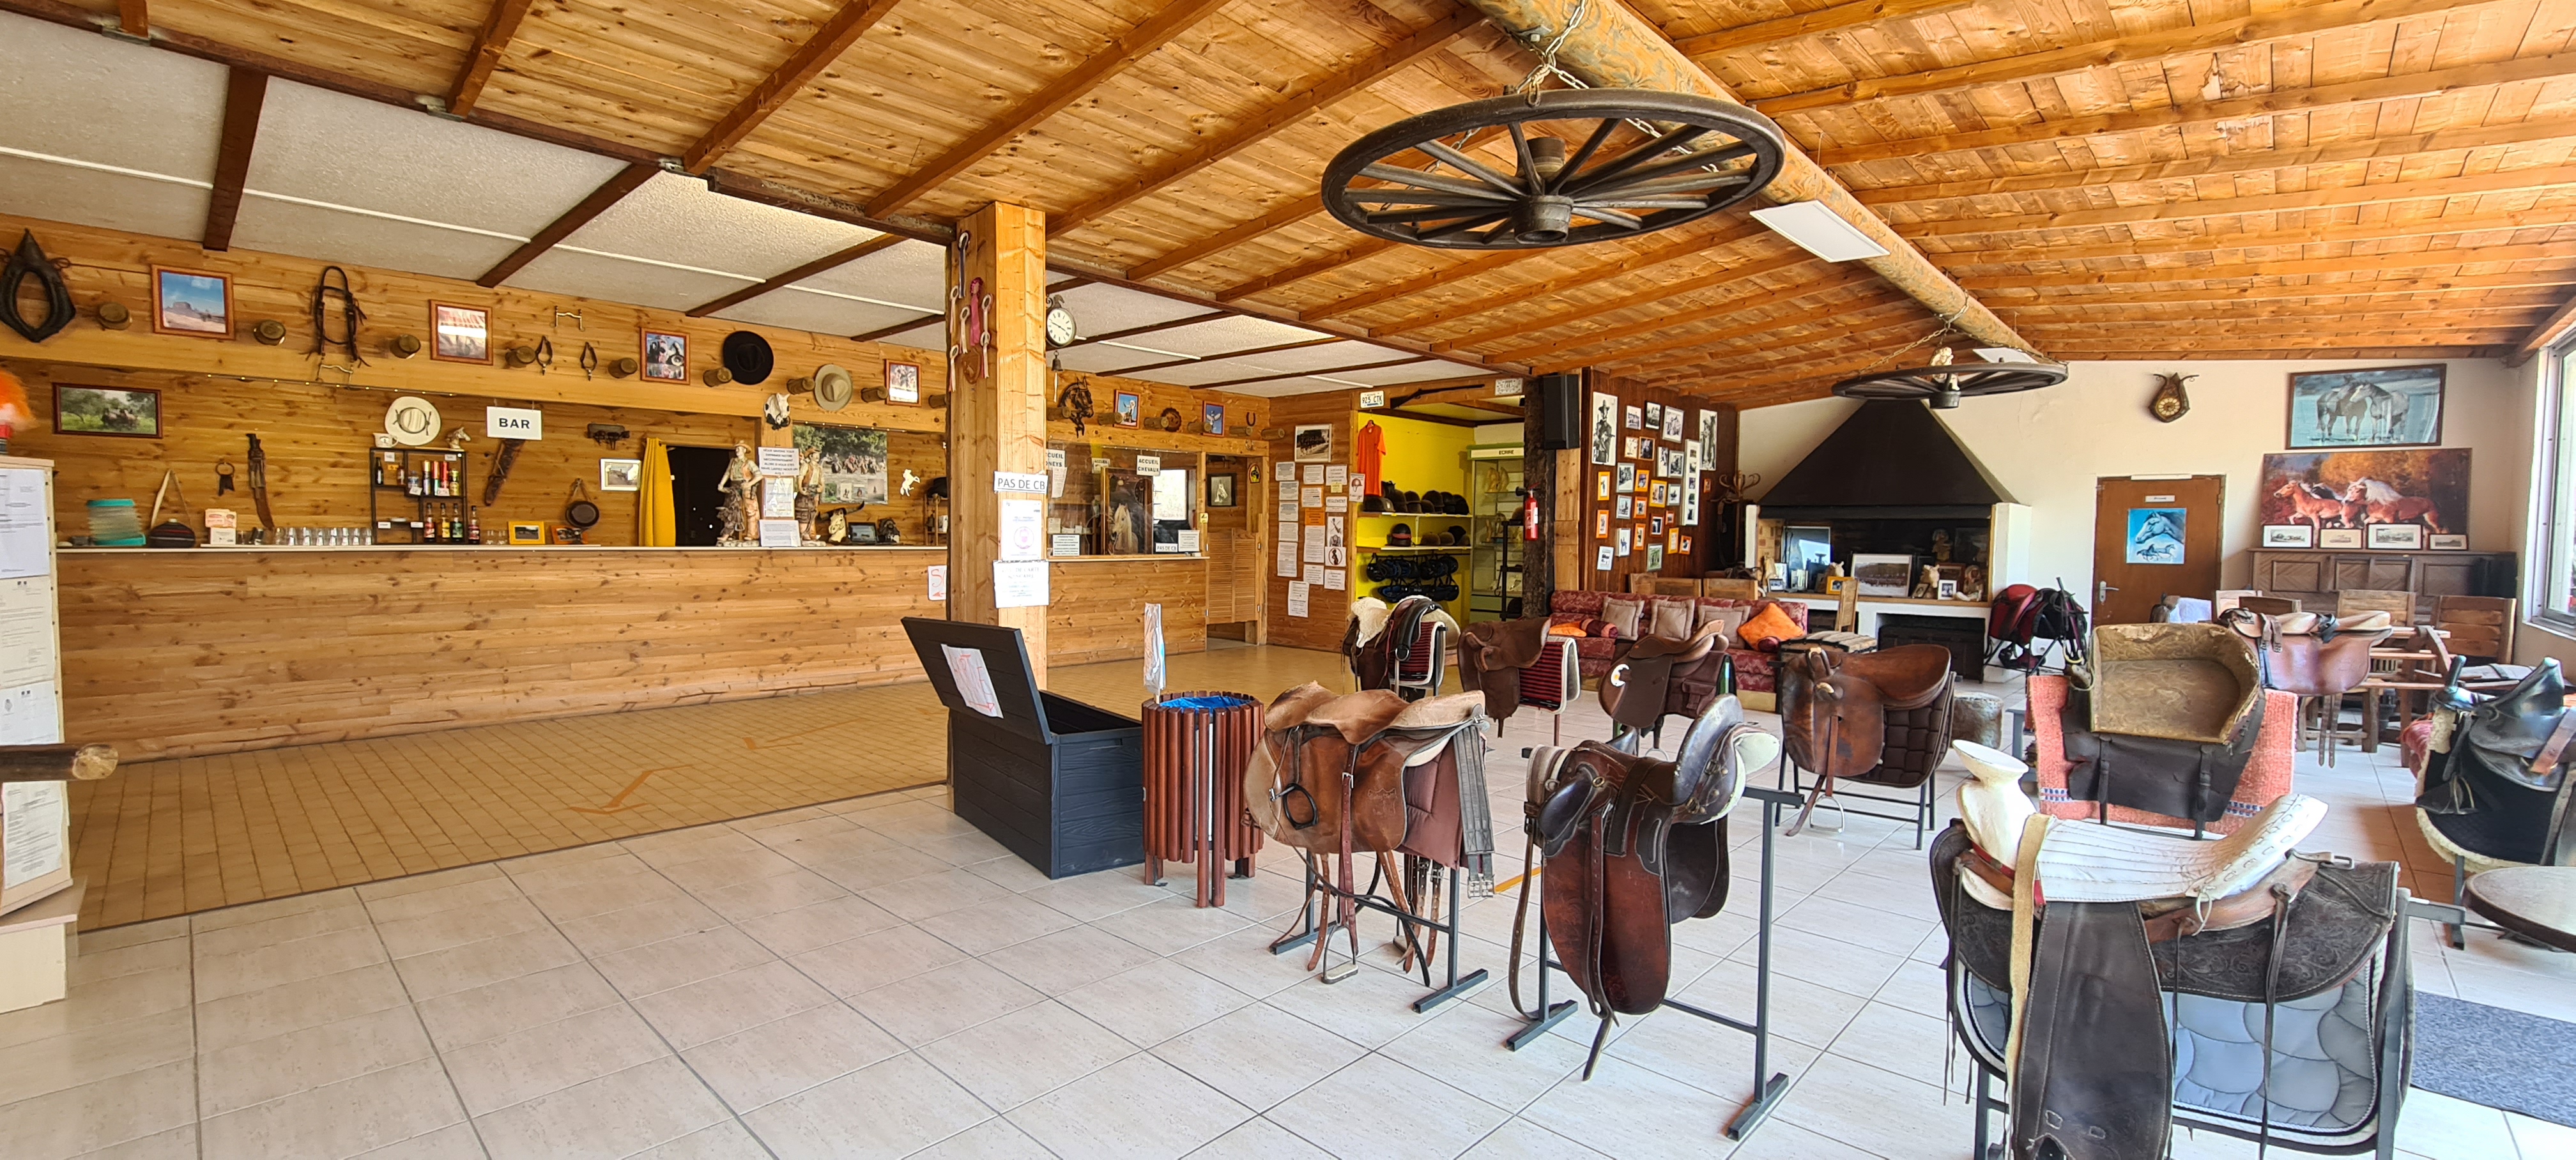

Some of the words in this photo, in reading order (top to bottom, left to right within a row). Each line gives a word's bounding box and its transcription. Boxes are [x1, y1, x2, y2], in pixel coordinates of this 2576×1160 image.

[499, 418, 530, 429] BAR
[998, 478, 1016, 488] PAS
[1018, 479, 1031, 489] DE
[1033, 480, 1045, 490] CB
[931, 569, 946, 588] S
